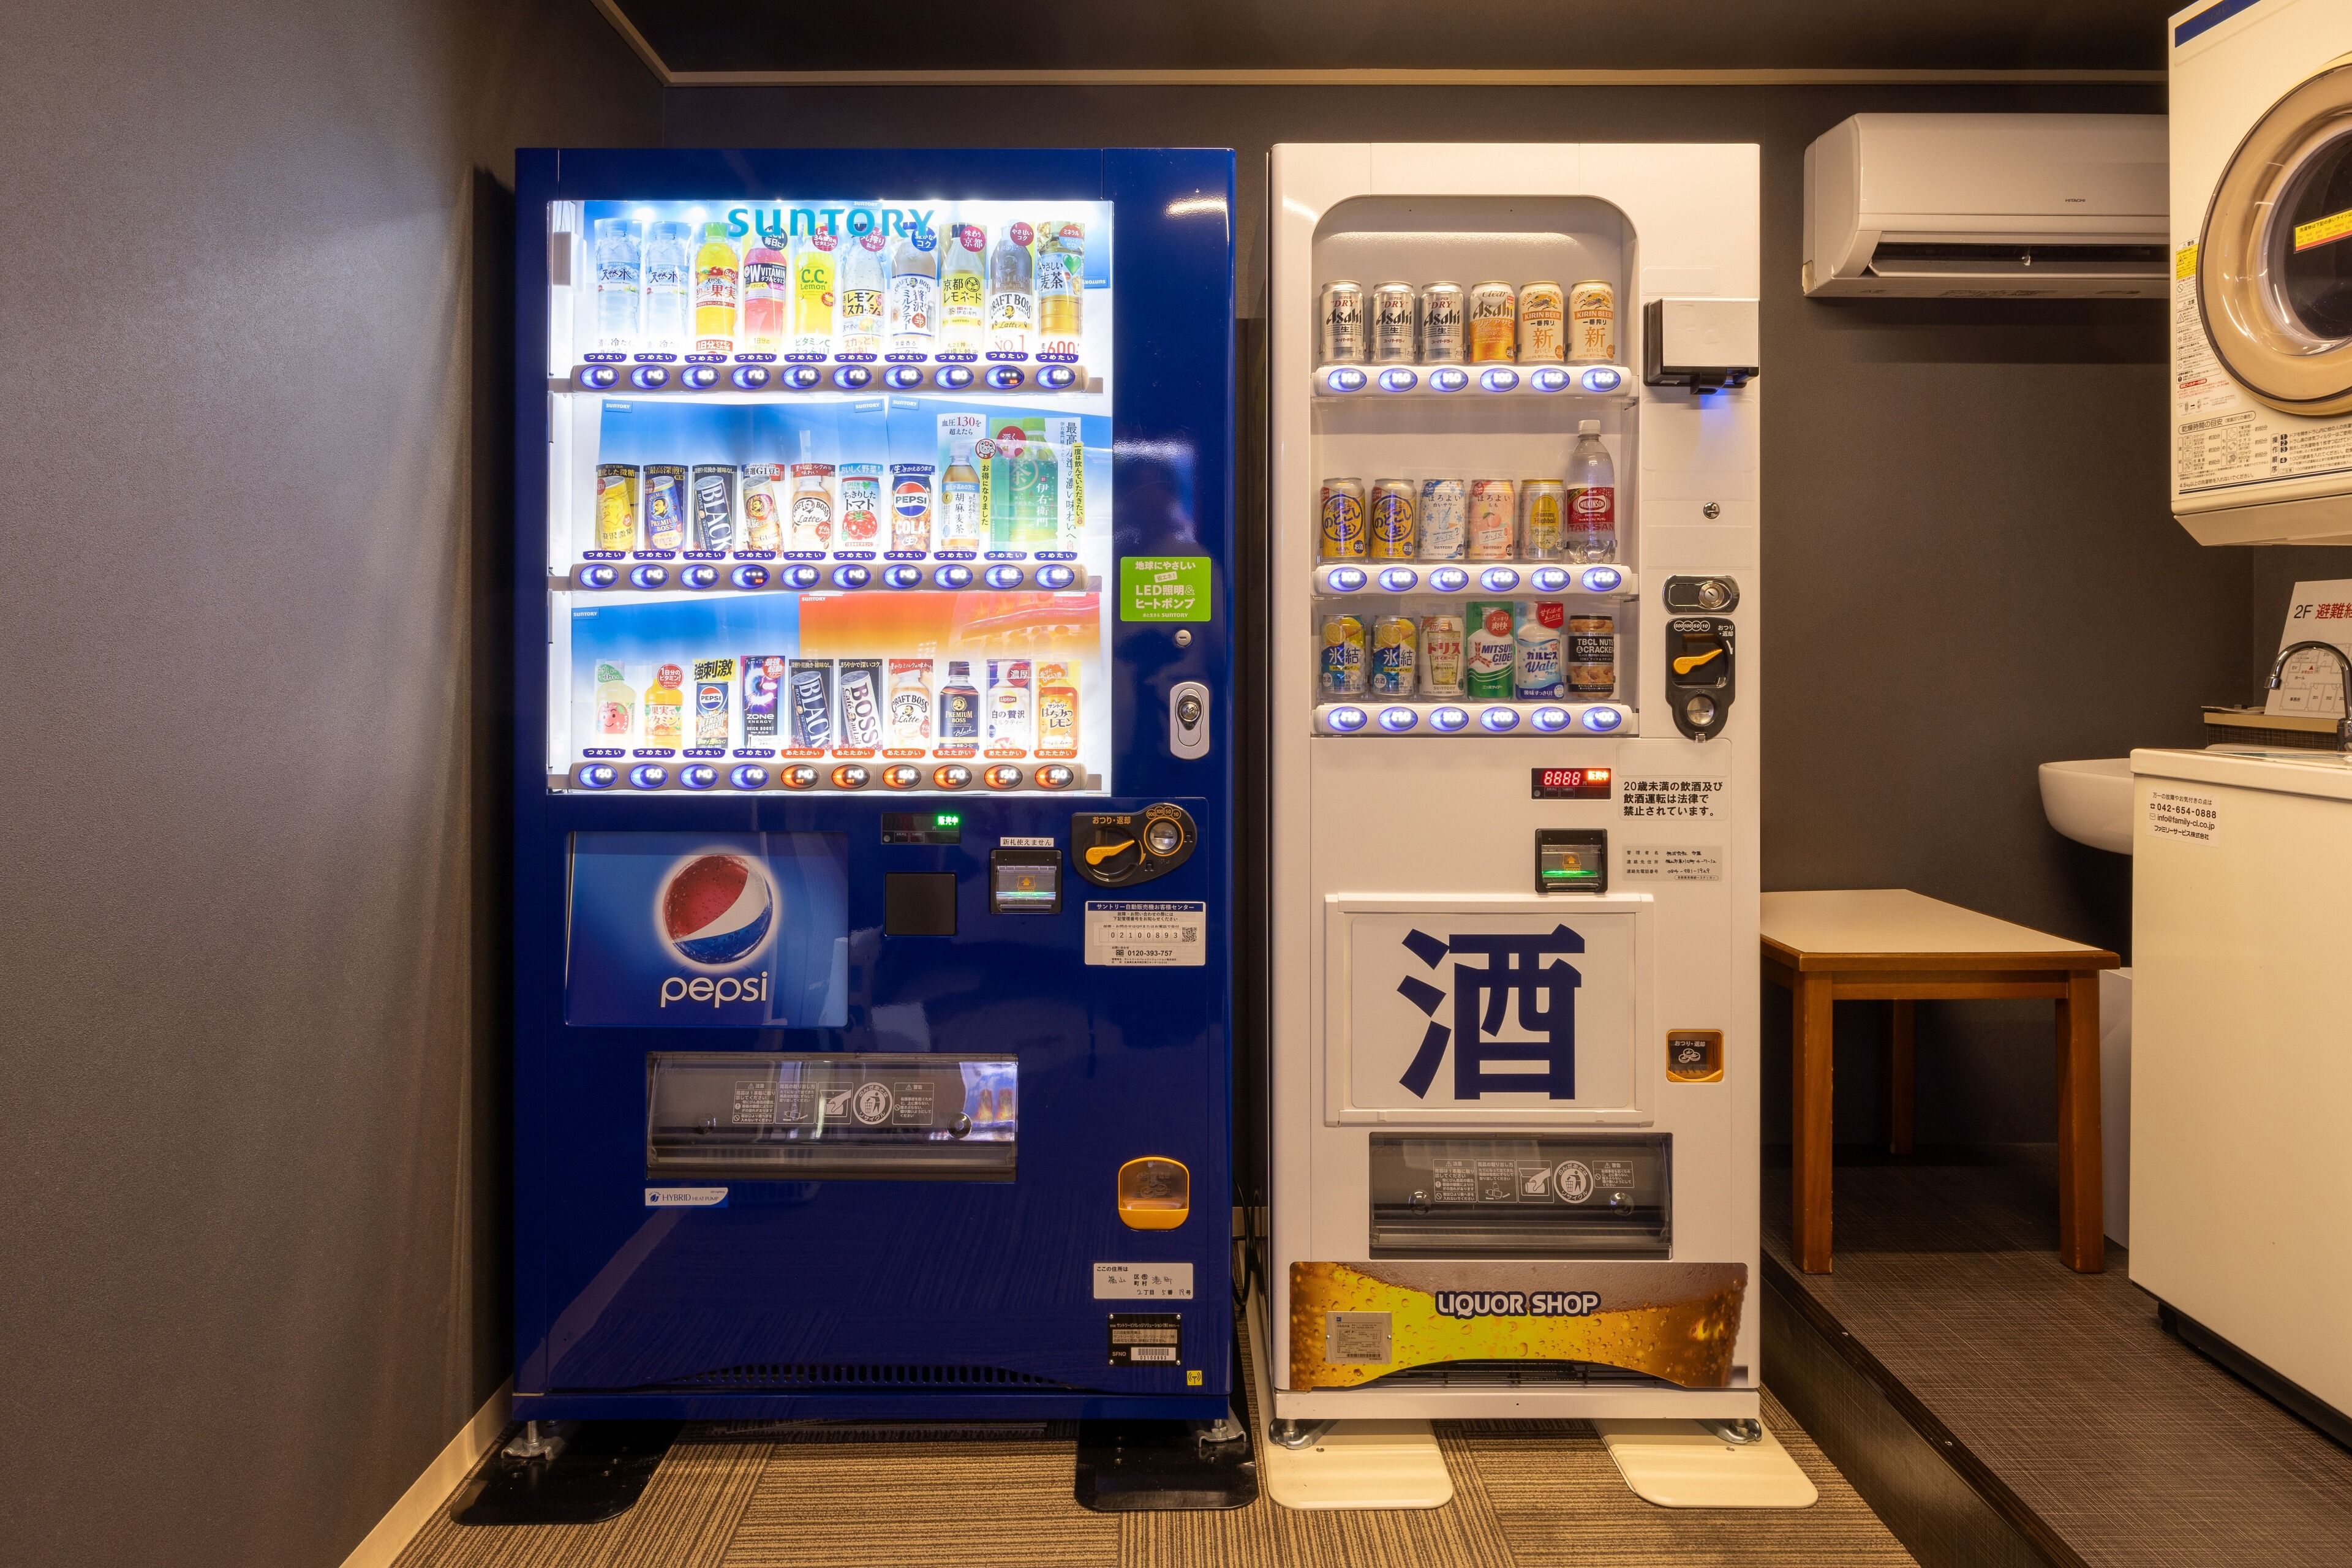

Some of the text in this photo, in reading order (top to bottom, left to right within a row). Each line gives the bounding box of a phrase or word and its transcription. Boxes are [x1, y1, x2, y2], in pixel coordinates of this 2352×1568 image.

[728, 208, 935, 238] SUNTORY
[963, 238, 983, 248] 京都
[943, 279, 963, 291] 京都
[1041, 272, 1064, 290] 麦茶
[847, 292, 874, 303] レモン
[944, 292, 982, 304] レモネード
[1326, 308, 1362, 325] Asahi
[1376, 309, 1412, 326] Asahi
[1424, 309, 1460, 326] Asahi
[1532, 328, 1554, 349] 新
[1585, 327, 1606, 348] 新
[942, 417, 981, 427] 血圧130を
[840, 465, 881, 475] おいしく野菜!
[843, 491, 876, 499] すっきりした
[895, 496, 927, 505] PEPSI
[981, 464, 990, 526] お得になりました
[845, 500, 874, 511] トマト
[1036, 483, 1050, 528] 伊右衛門
[1579, 498, 1605, 508] WILKINSON
[702, 484, 733, 551] BLACK
[797, 514, 823, 523] Latte
[955, 492, 965, 534] 胡麻麦茶
[895, 521, 925, 535] COLA
[1136, 561, 1196, 570] 地球にやさしい
[1136, 584, 1195, 596] LED照明&
[1136, 598, 1196, 609] ヒートポンプ
[2294, 605, 2313, 619] 2F
[1491, 622, 1509, 631] 爽快
[1428, 643, 1461, 654] トリス
[1329, 647, 1359, 664] 氷結
[1383, 649, 1412, 666] 氷結
[694, 659, 733, 681] 強刺激
[1525, 661, 1558, 673] Water
[1010, 670, 1028, 680] 濃厚
[892, 695, 930, 713] CRAFT BOSS
[652, 706, 675, 715] 果実で
[851, 682, 878, 744] BOSS
[1042, 708, 1073, 718] はちみつ
[896, 715, 922, 724] Latte
[1049, 718, 1073, 728] レモン
[1544, 771, 1581, 786] 8888
[1624, 781, 1723, 792] 20歳未満の飲酒及び
[1623, 794, 1709, 804] 飲酒運転は法律で
[2152, 792, 2212, 805] 万一の故障やお気付きの点は
[1623, 805, 1714, 817] 禁止されています。
[2157, 803, 2217, 819] 042-654-0888
[938, 815, 959, 826] 販売中
[2157, 813, 2215, 831] info@family-cl.co.jp
[2154, 825, 2209, 840] ファミリーサービス株式会社
[1003, 838, 1052, 846] 新札使えません
[660, 971, 768, 1008] pepsi
[1396, 923, 1585, 1100] 酒
[1558, 1163, 1588, 1176] のんだあとは
[1561, 1190, 1588, 1200] リサイクル
[1436, 1293, 1599, 1316] LIQUOR SHOP
